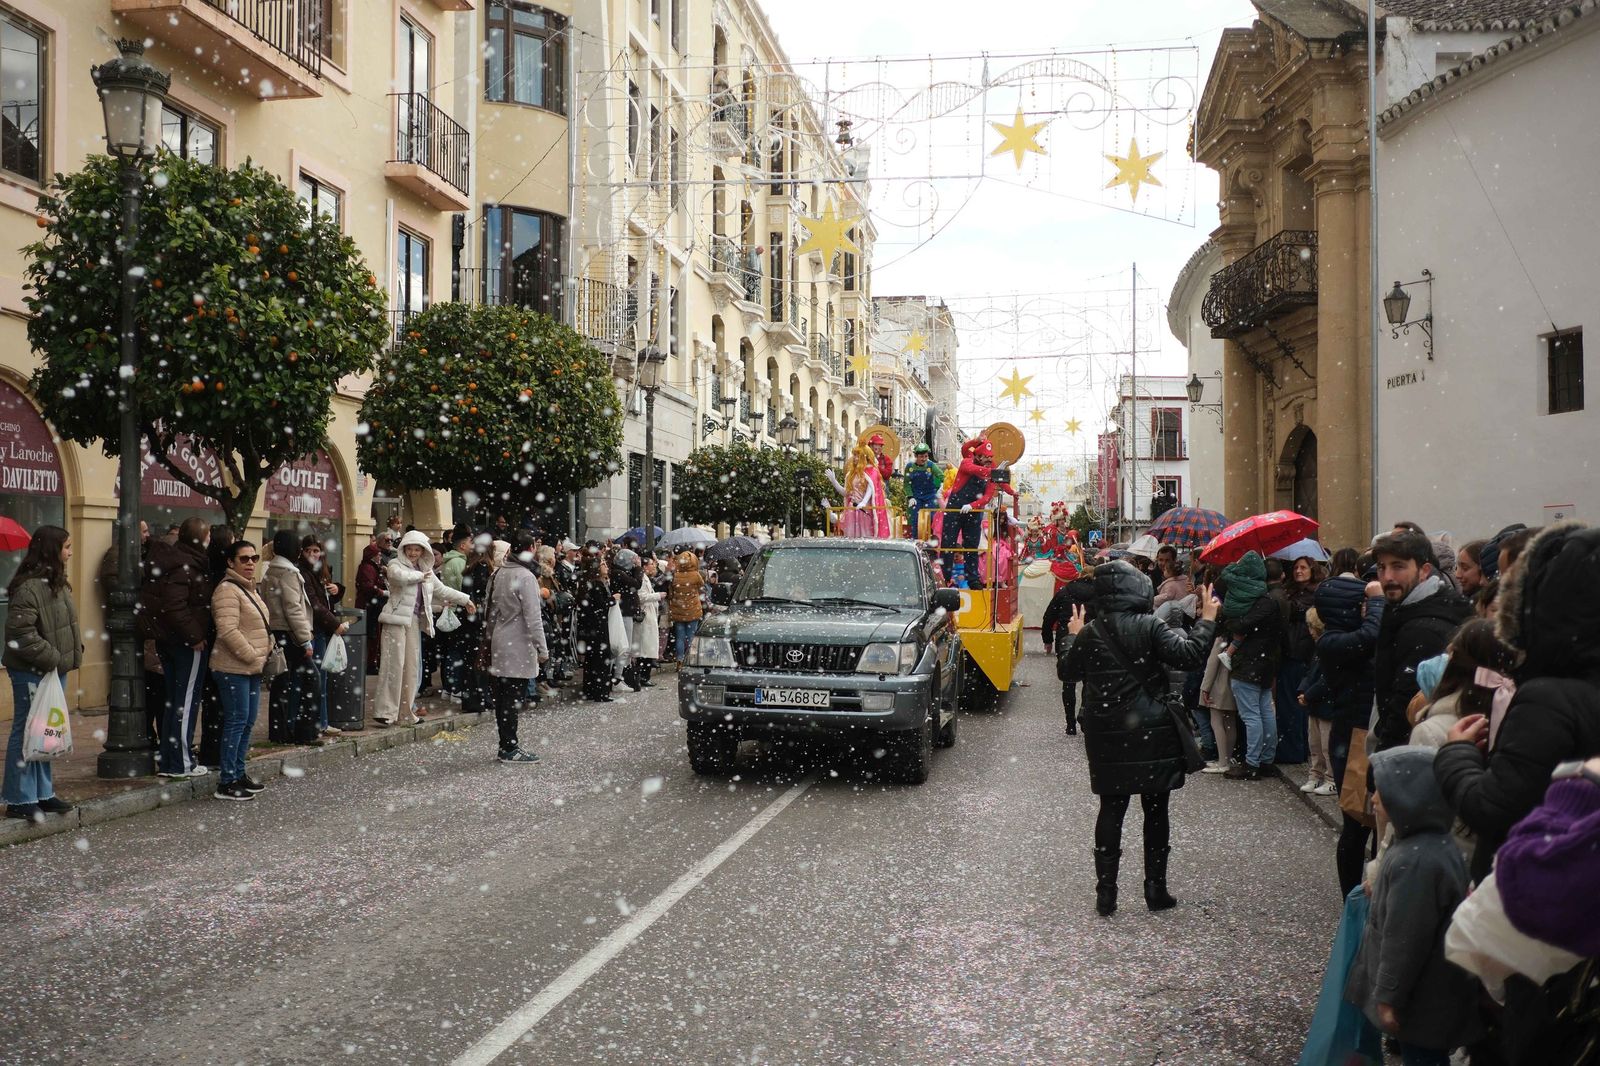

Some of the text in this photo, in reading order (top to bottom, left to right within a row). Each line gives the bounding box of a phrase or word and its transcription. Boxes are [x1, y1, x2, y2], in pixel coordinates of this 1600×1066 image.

[1387, 372, 1417, 389] PUERTA
[10, 441, 54, 463] Laroche
[2, 466, 58, 493] DAVILETTO
[153, 478, 191, 498] DAVILETTO
[280, 466, 329, 491] OUTLET
[761, 689, 829, 706] MA 5468 CZ
